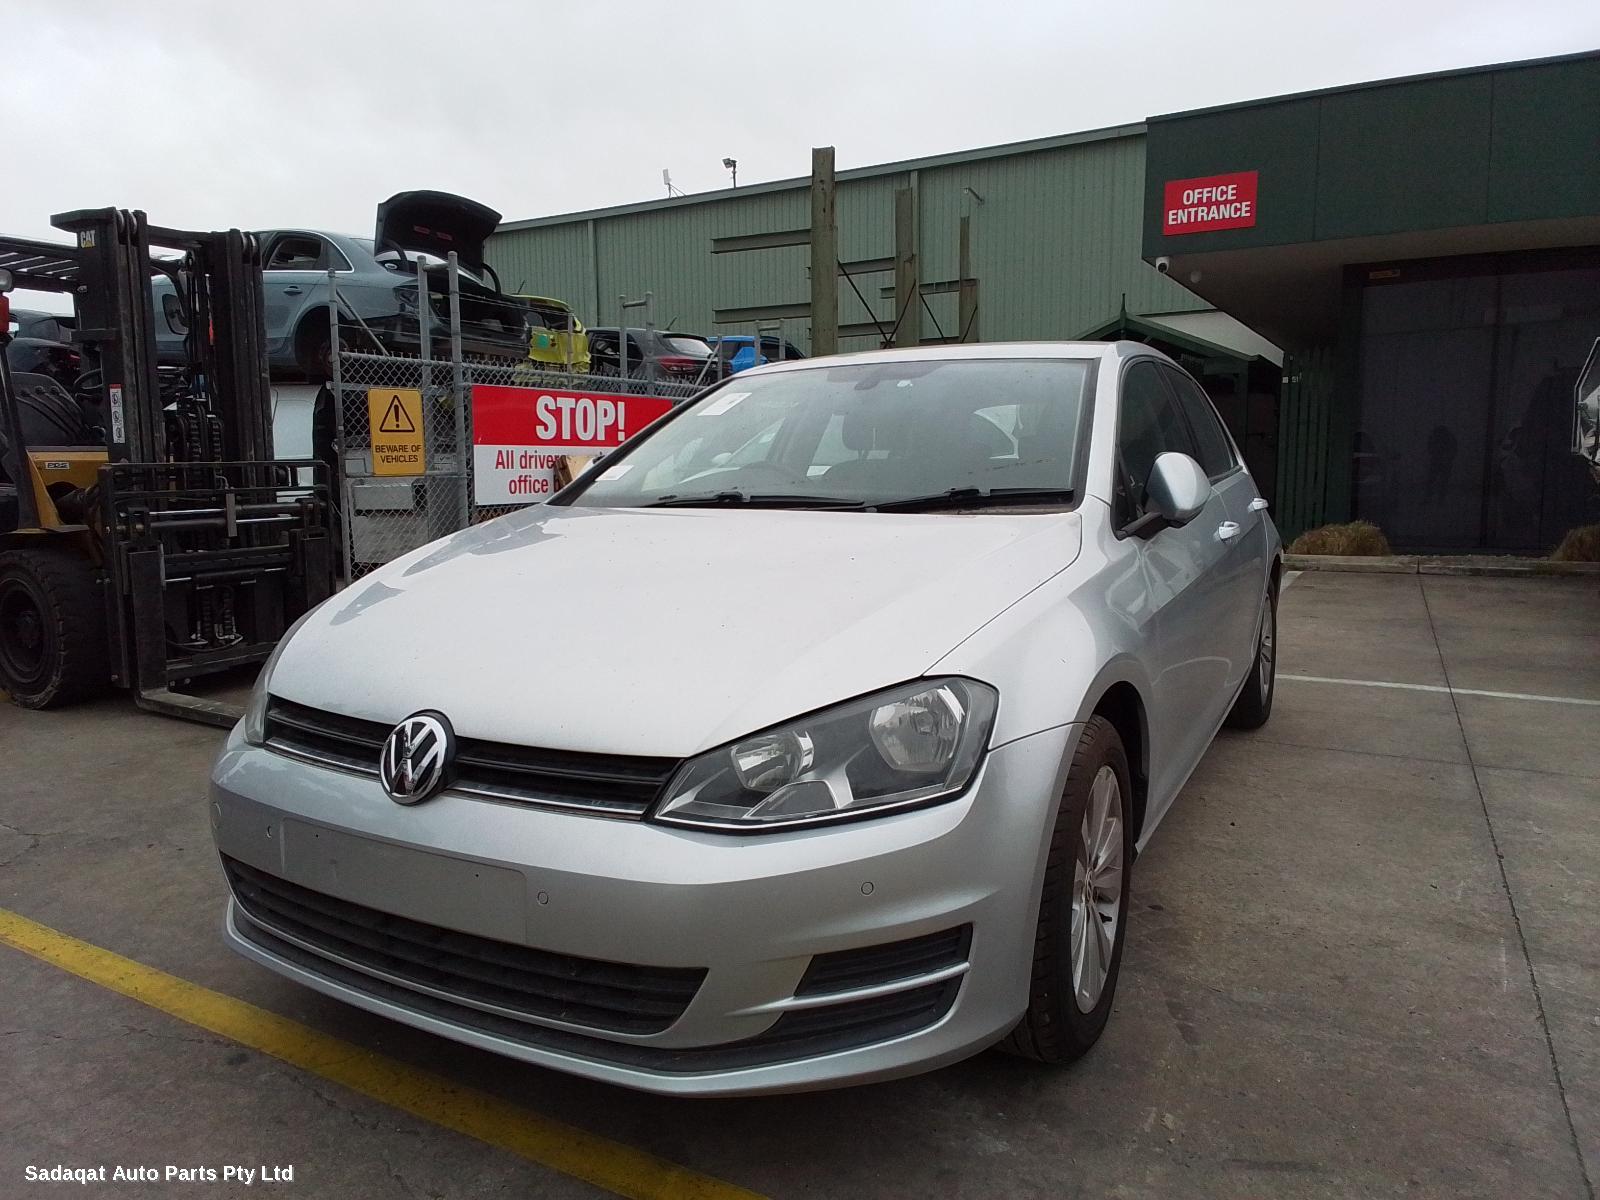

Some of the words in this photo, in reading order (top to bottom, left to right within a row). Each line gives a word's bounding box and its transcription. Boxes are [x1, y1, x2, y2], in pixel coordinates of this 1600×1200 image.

[1183, 184, 1237, 205] OFFICE
[1168, 201, 1251, 225] ENTRANCE
[80, 230, 96, 248] CAT
[535, 395, 626, 441] STOP!
[375, 444, 409, 453] BEWARE
[411, 444, 422, 453] OF
[380, 455, 419, 464] VEHICLES
[495, 450, 514, 469] All
[508, 475, 549, 495] office
